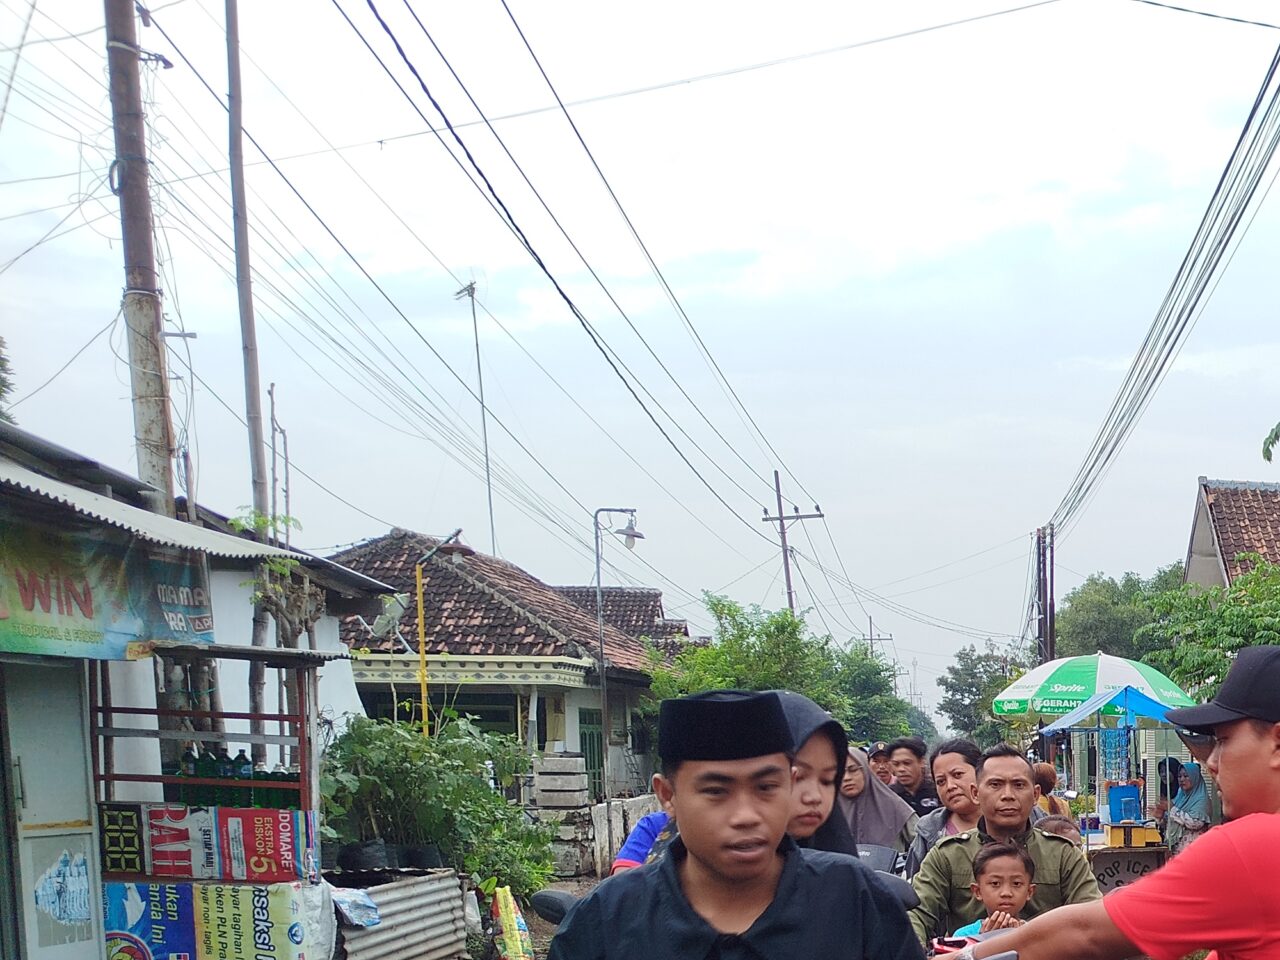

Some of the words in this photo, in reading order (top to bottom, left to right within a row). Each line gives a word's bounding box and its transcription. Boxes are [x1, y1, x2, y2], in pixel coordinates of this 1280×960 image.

[1050, 683, 1087, 693] Sprite
[201, 827, 214, 851] SETIAP
[253, 816, 265, 856] DISKON
[263, 816, 274, 856] EKSTRA
[202, 850, 214, 868] HARI
[1096, 860, 1121, 886] POP
[152, 924, 167, 945] Ini
[216, 915, 228, 938] PLN
[231, 912, 244, 954] tagihan
